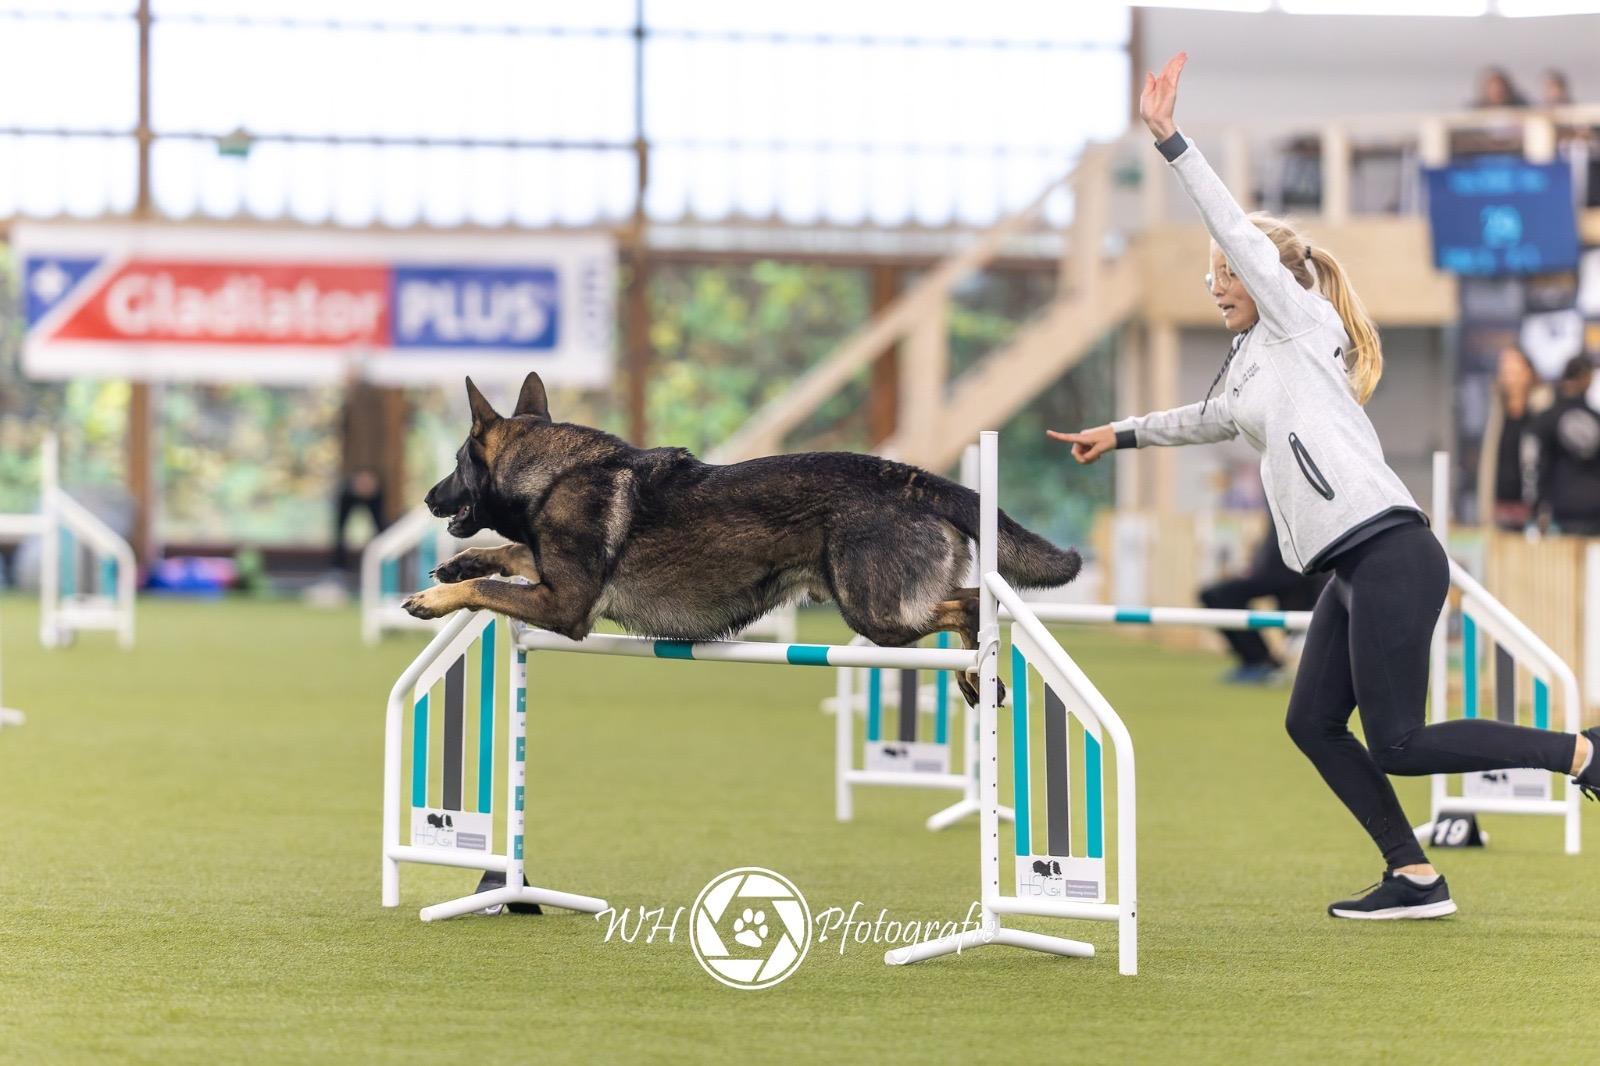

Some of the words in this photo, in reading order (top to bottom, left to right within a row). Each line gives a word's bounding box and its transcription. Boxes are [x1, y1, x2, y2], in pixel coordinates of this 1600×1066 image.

[106, 272, 381, 336] Gladiator
[401, 281, 547, 341] PLUS
[1433, 818, 1469, 845] 19
